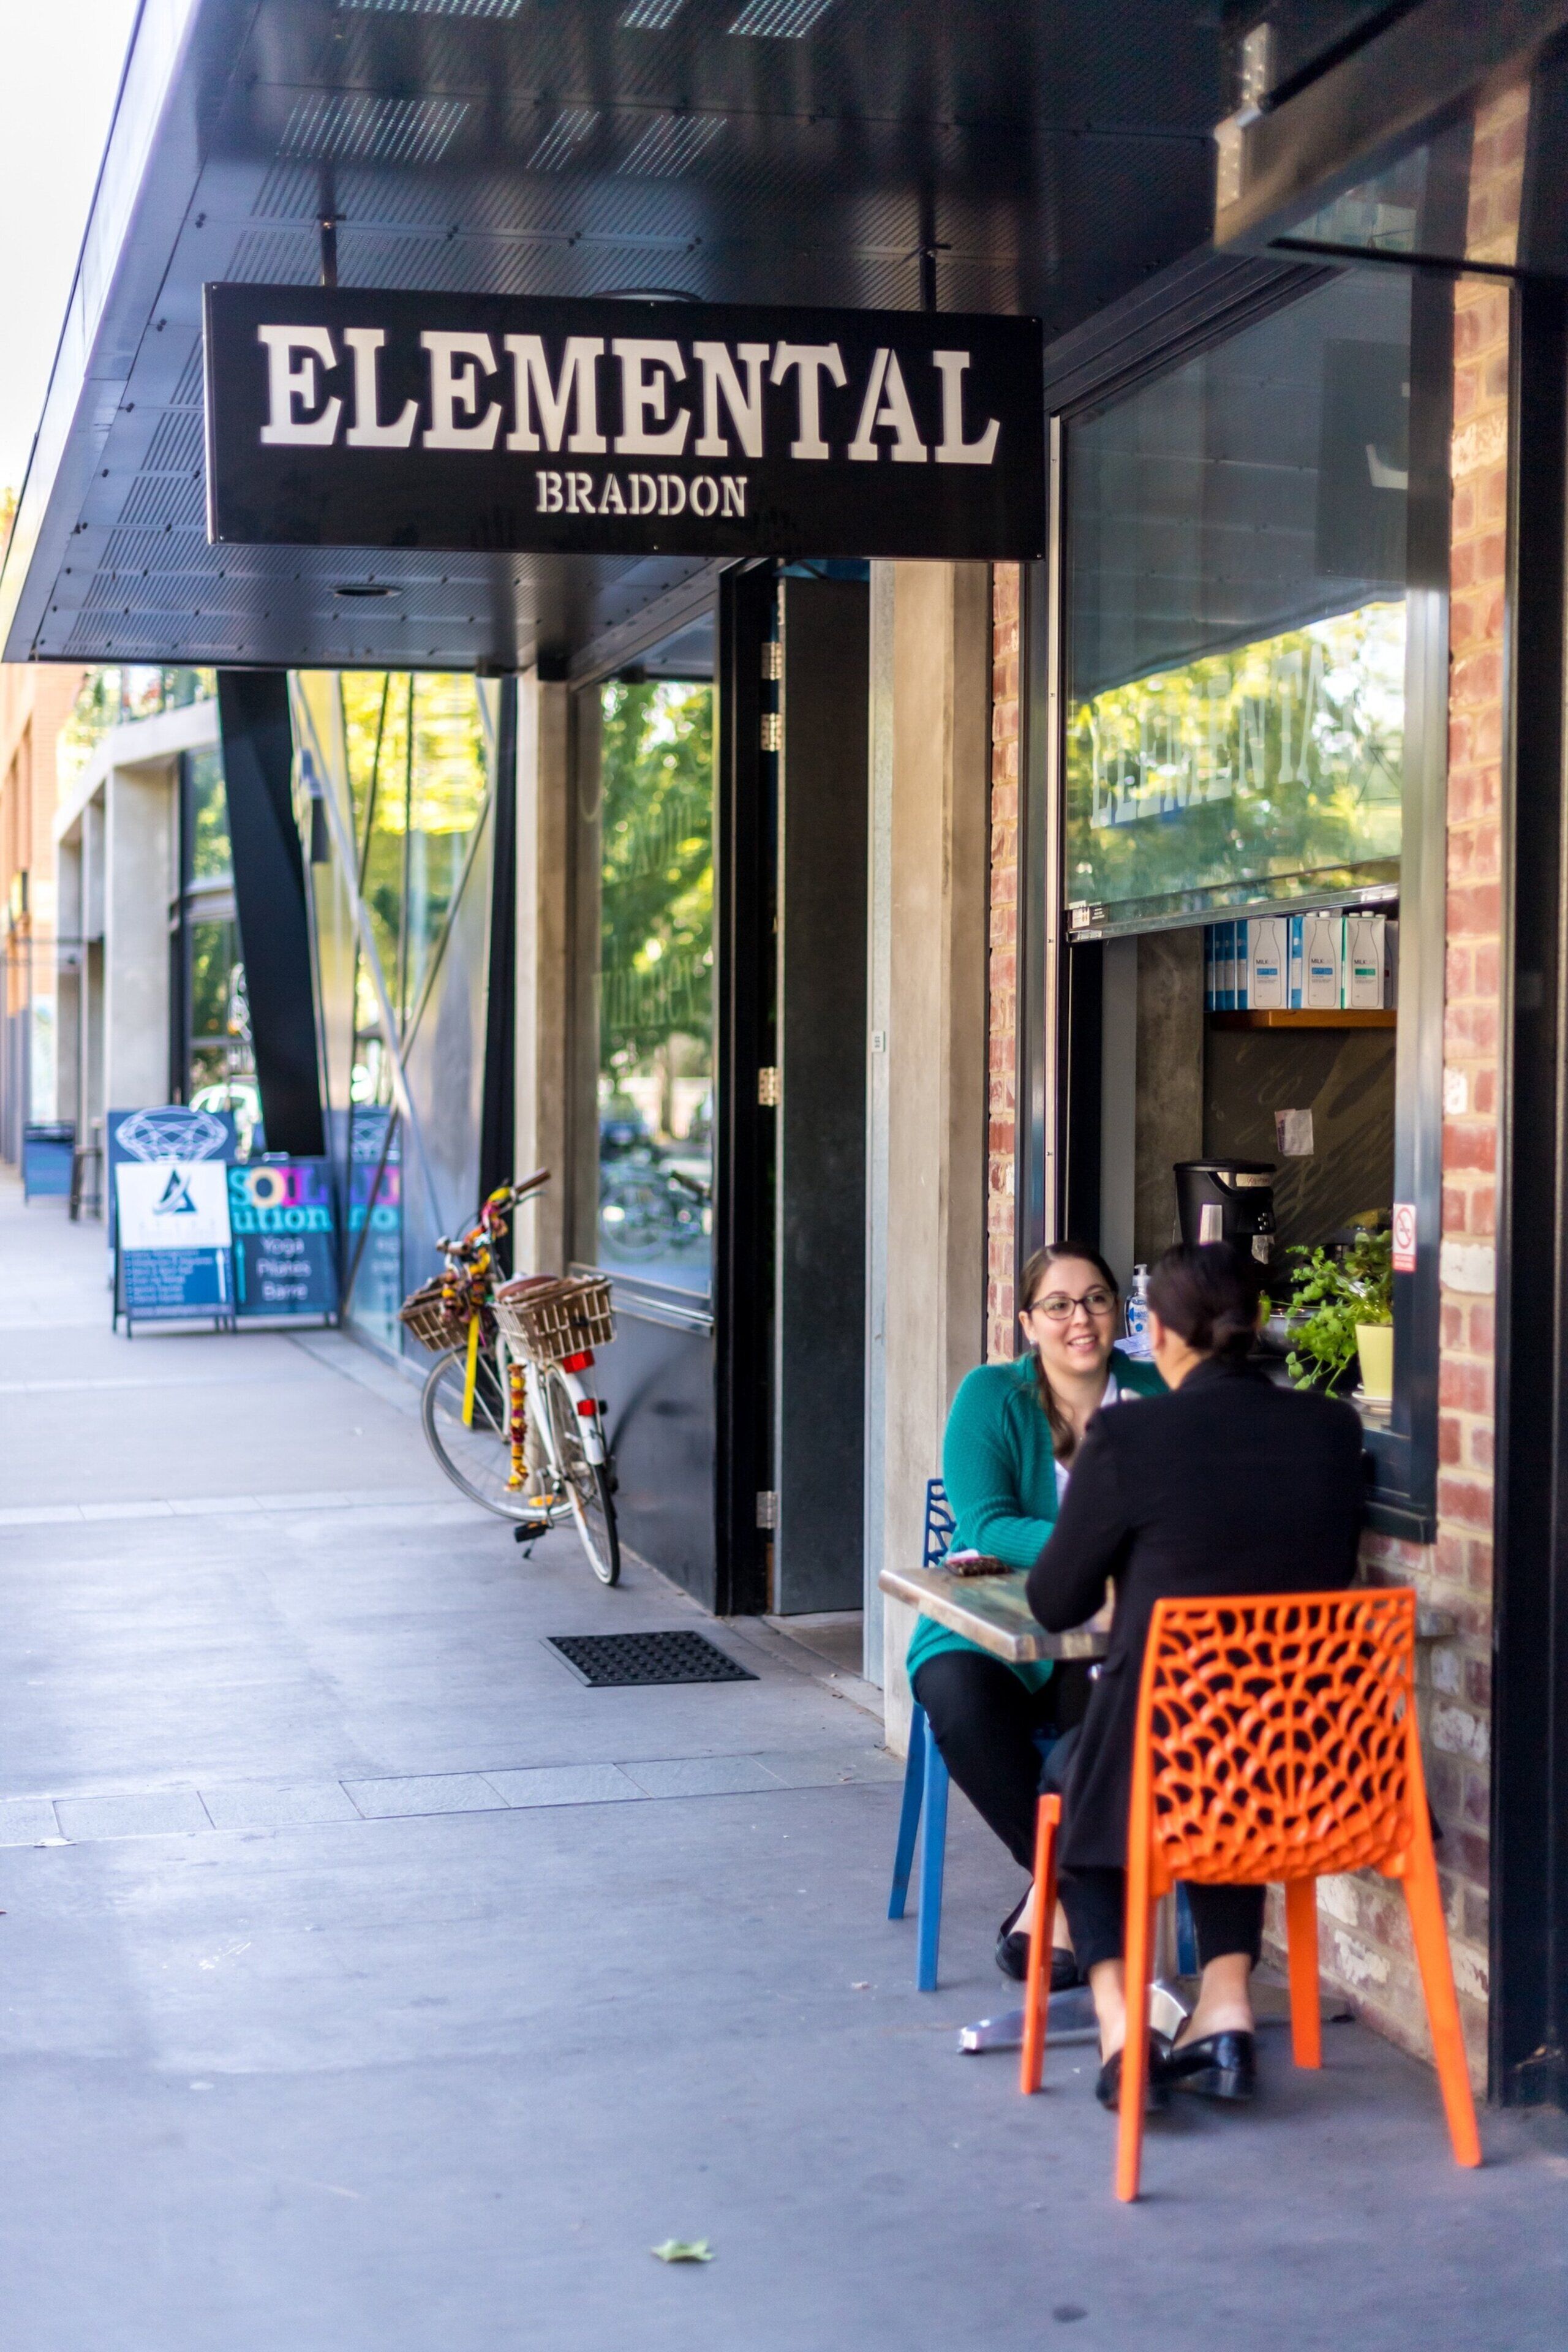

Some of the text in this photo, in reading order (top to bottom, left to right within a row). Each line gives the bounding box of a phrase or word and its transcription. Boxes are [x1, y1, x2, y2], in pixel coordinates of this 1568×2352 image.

[257, 325, 1001, 465] ELEMENTAL
[536, 471, 748, 517] BRADDON
[261, 1236, 305, 1258] Yoga
[262, 1281, 308, 1301] Barre
